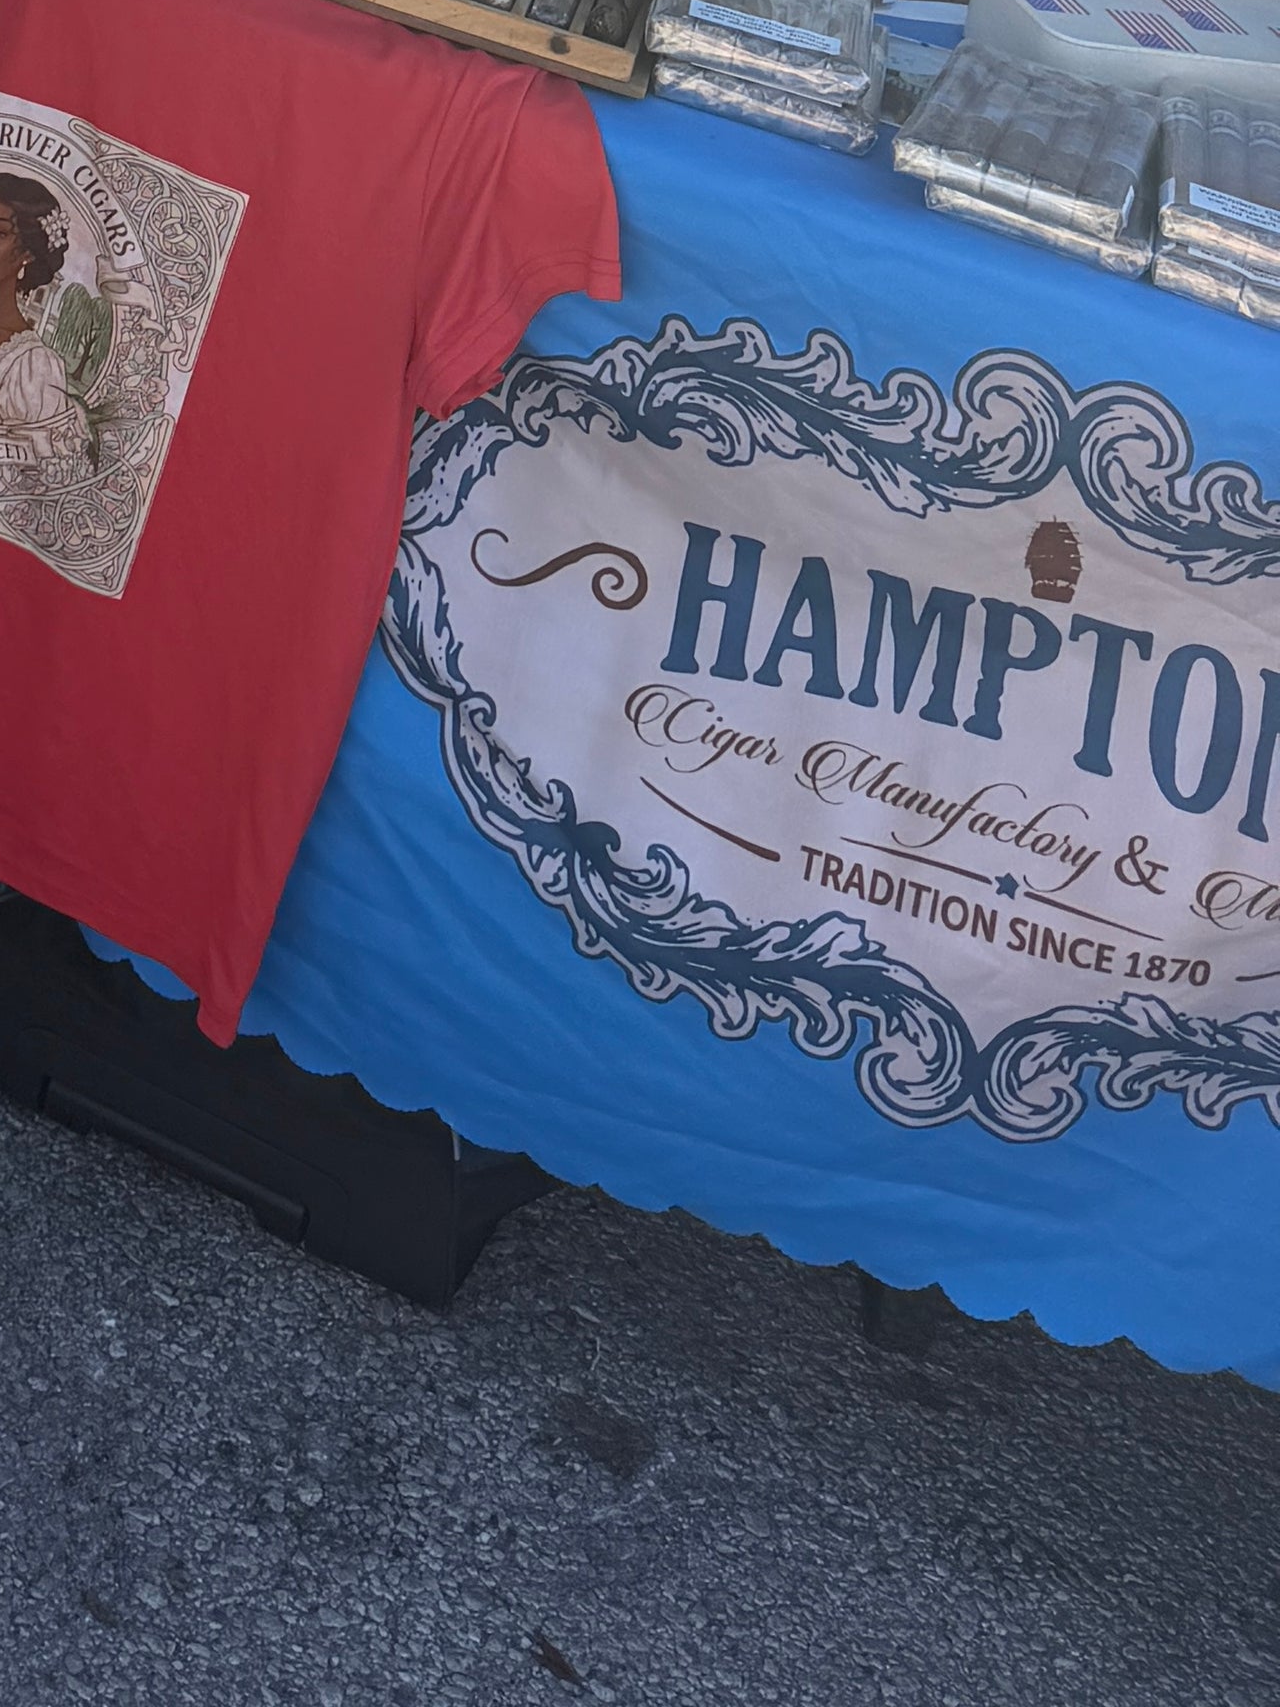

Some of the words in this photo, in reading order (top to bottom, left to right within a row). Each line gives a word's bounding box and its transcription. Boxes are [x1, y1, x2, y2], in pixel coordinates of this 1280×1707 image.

[72, 163, 136, 259] CIGARS
[625, 683, 784, 774] Cigar
[797, 739, 1101, 893] Manufactory
[1114, 835, 1169, 895] &
[800, 845, 997, 944] TRADITION
[1006, 919, 1115, 975] SINCE
[1124, 949, 1212, 987] 1870
